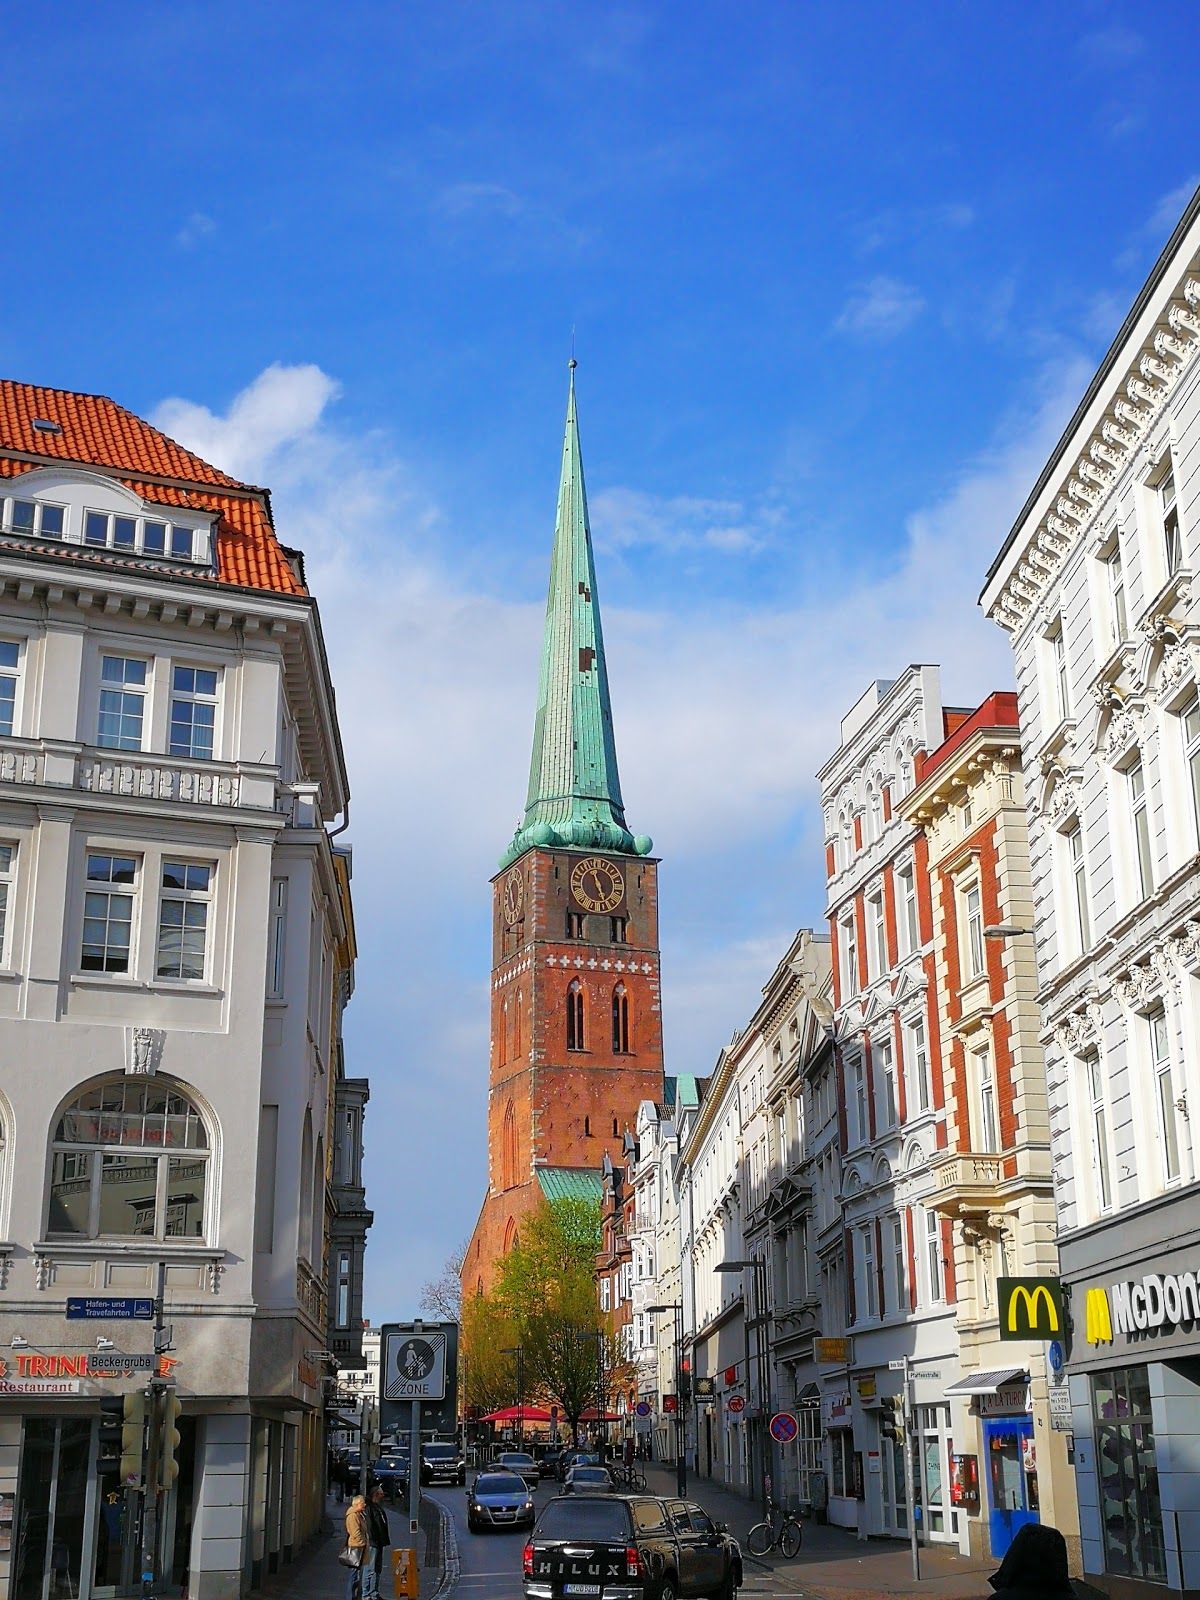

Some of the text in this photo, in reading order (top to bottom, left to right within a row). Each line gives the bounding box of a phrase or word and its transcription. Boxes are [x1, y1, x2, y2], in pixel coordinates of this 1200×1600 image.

[86, 1300, 126, 1308] Hafen- und
[86, 1309, 131, 1317] Travefahrten
[91, 1356, 151, 1369] Beckergrube
[0, 1381, 73, 1393] Restaurant
[400, 1384, 429, 1394] ZONE
[540, 1562, 620, 1576] HILUX
